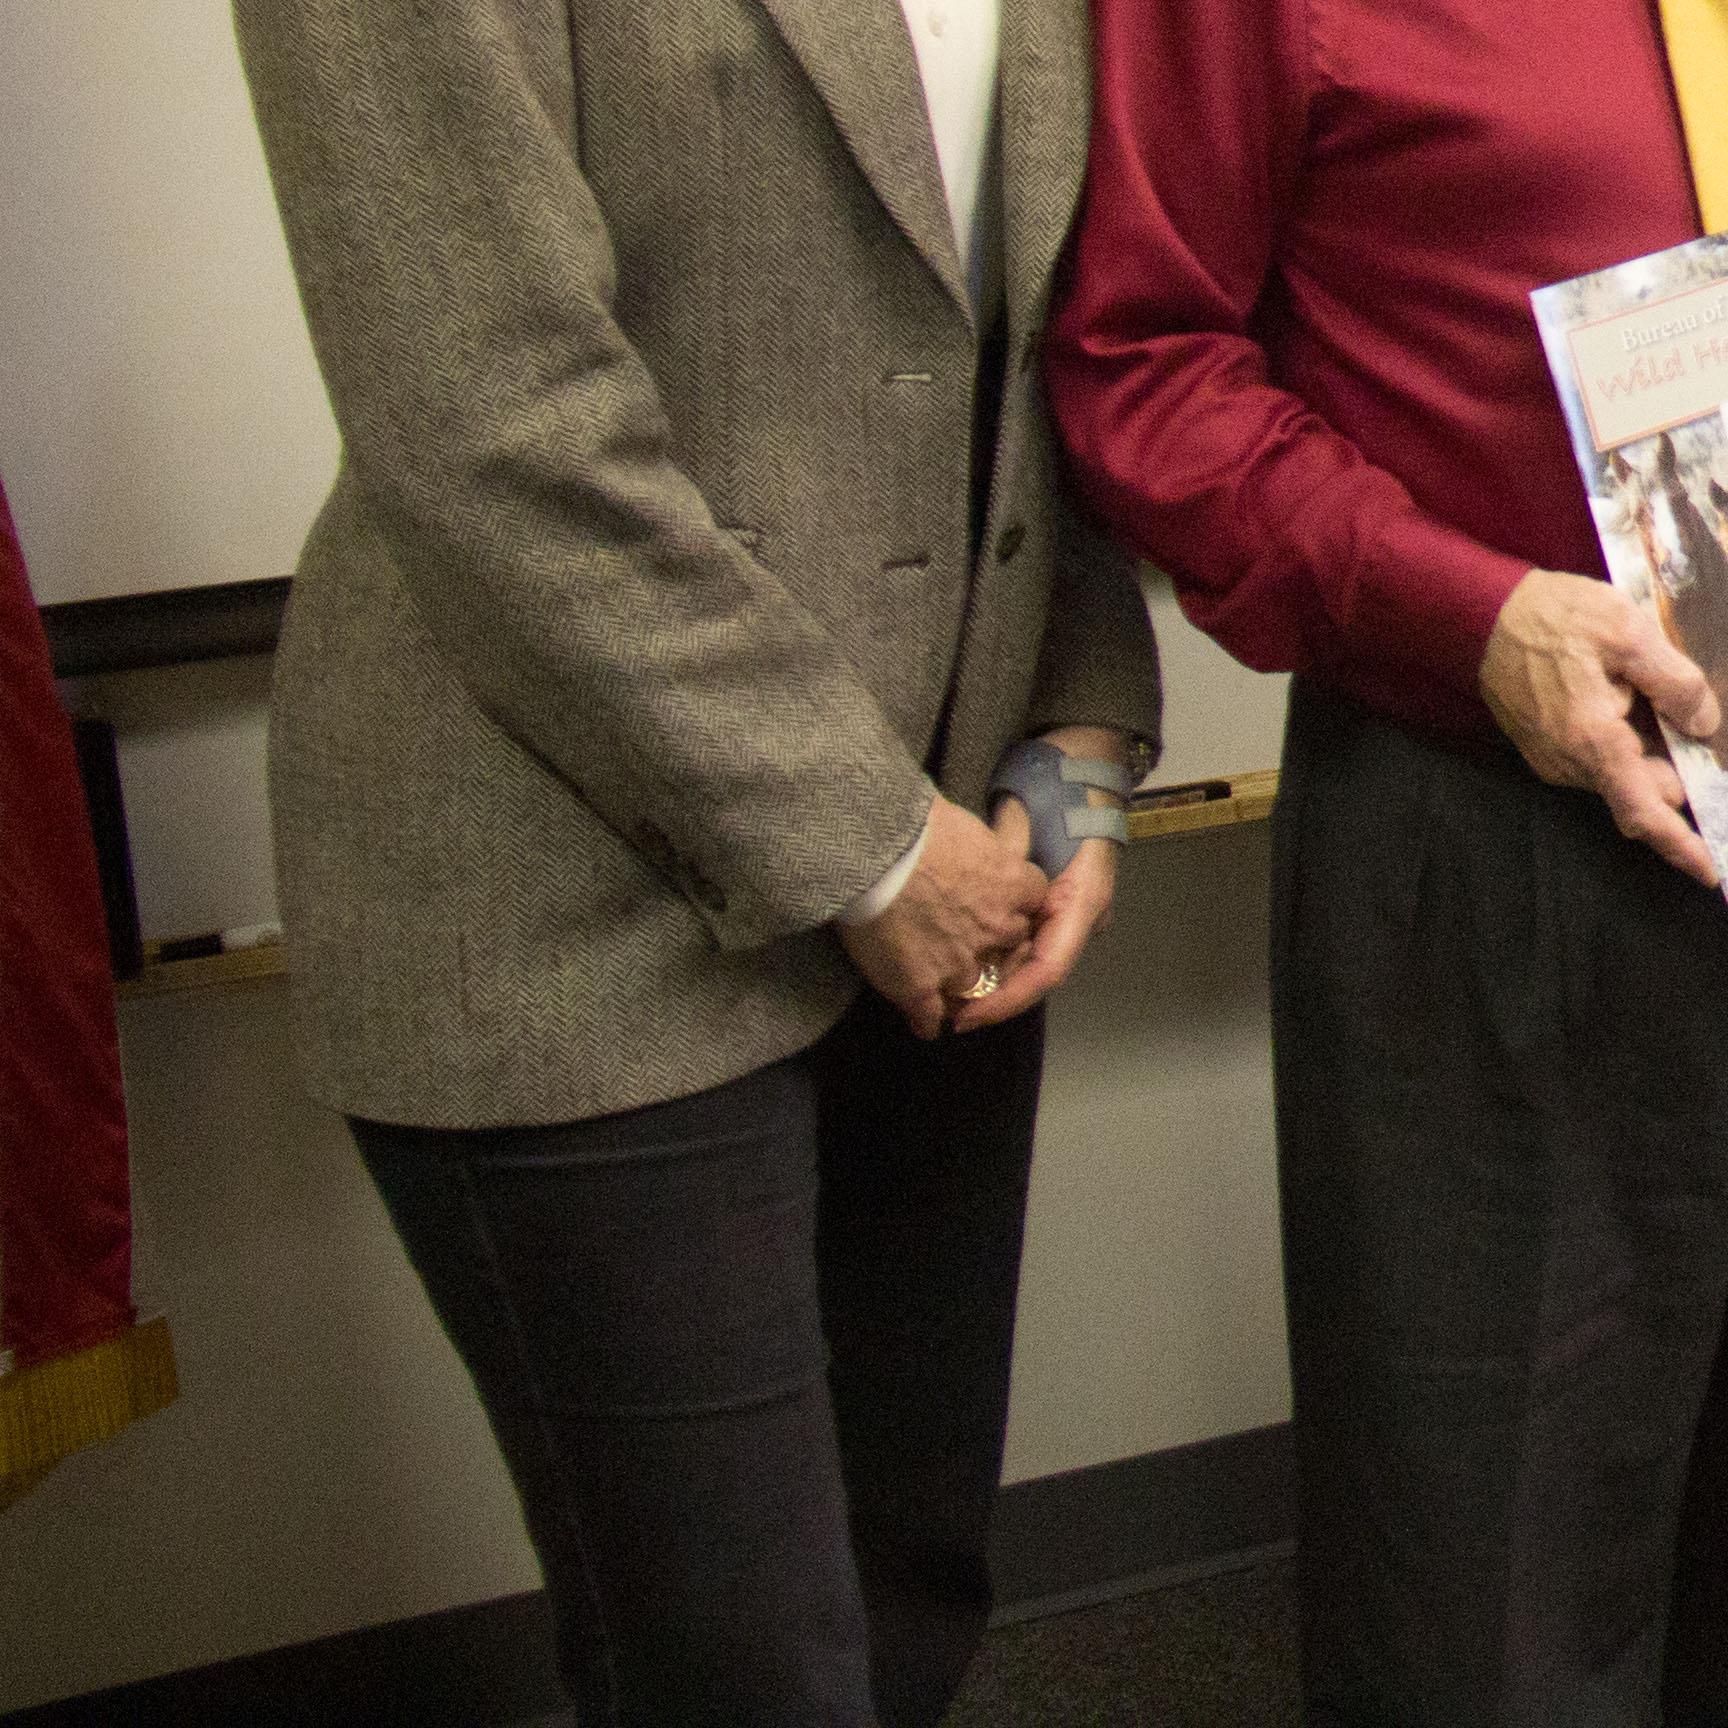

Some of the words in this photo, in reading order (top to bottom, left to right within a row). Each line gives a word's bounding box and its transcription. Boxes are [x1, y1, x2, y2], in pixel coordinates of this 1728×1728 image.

[1622, 312, 1701, 352] Bureau
[1702, 297, 1728, 325] of
[1597, 347, 1685, 401] Wild
